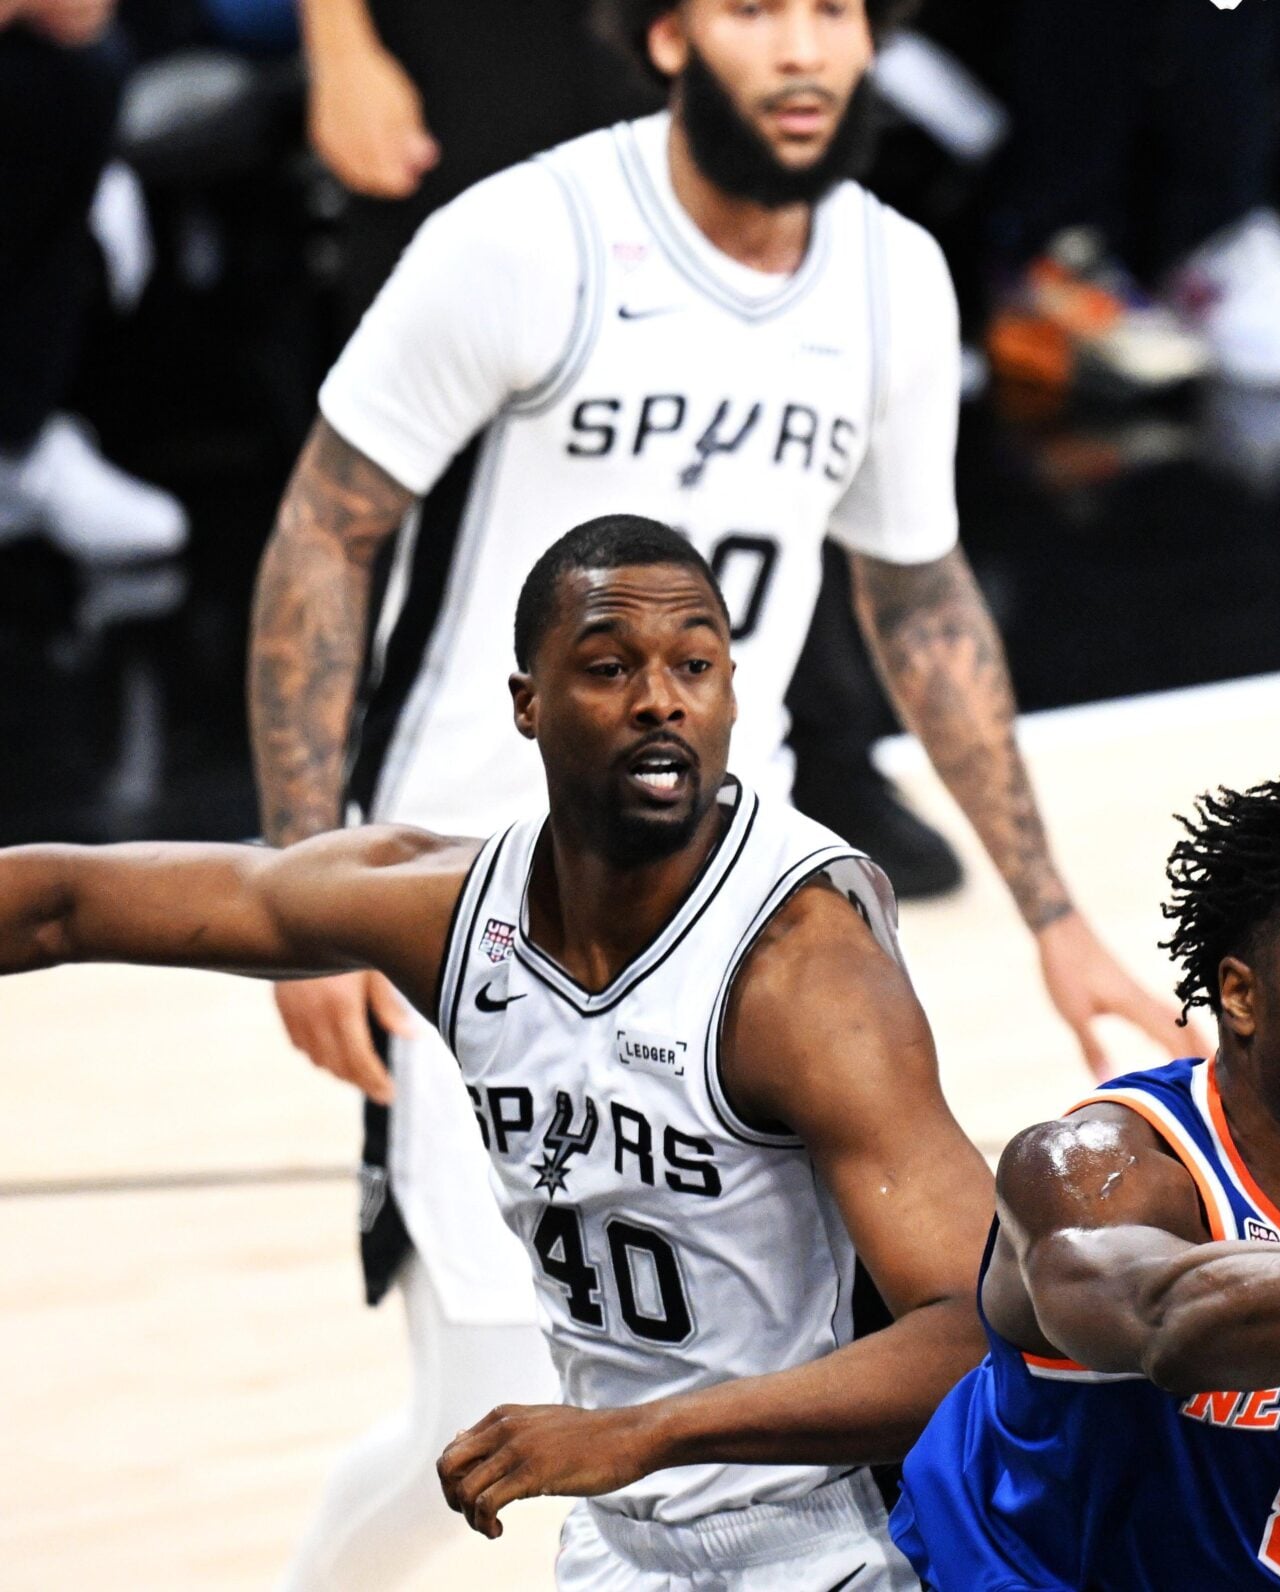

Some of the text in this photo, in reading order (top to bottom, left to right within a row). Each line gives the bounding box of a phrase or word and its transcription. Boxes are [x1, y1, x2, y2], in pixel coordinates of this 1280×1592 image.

[566, 393, 858, 487] SPURS
[625, 1041, 676, 1065] LEDGER
[531, 1203, 698, 1349] 40
